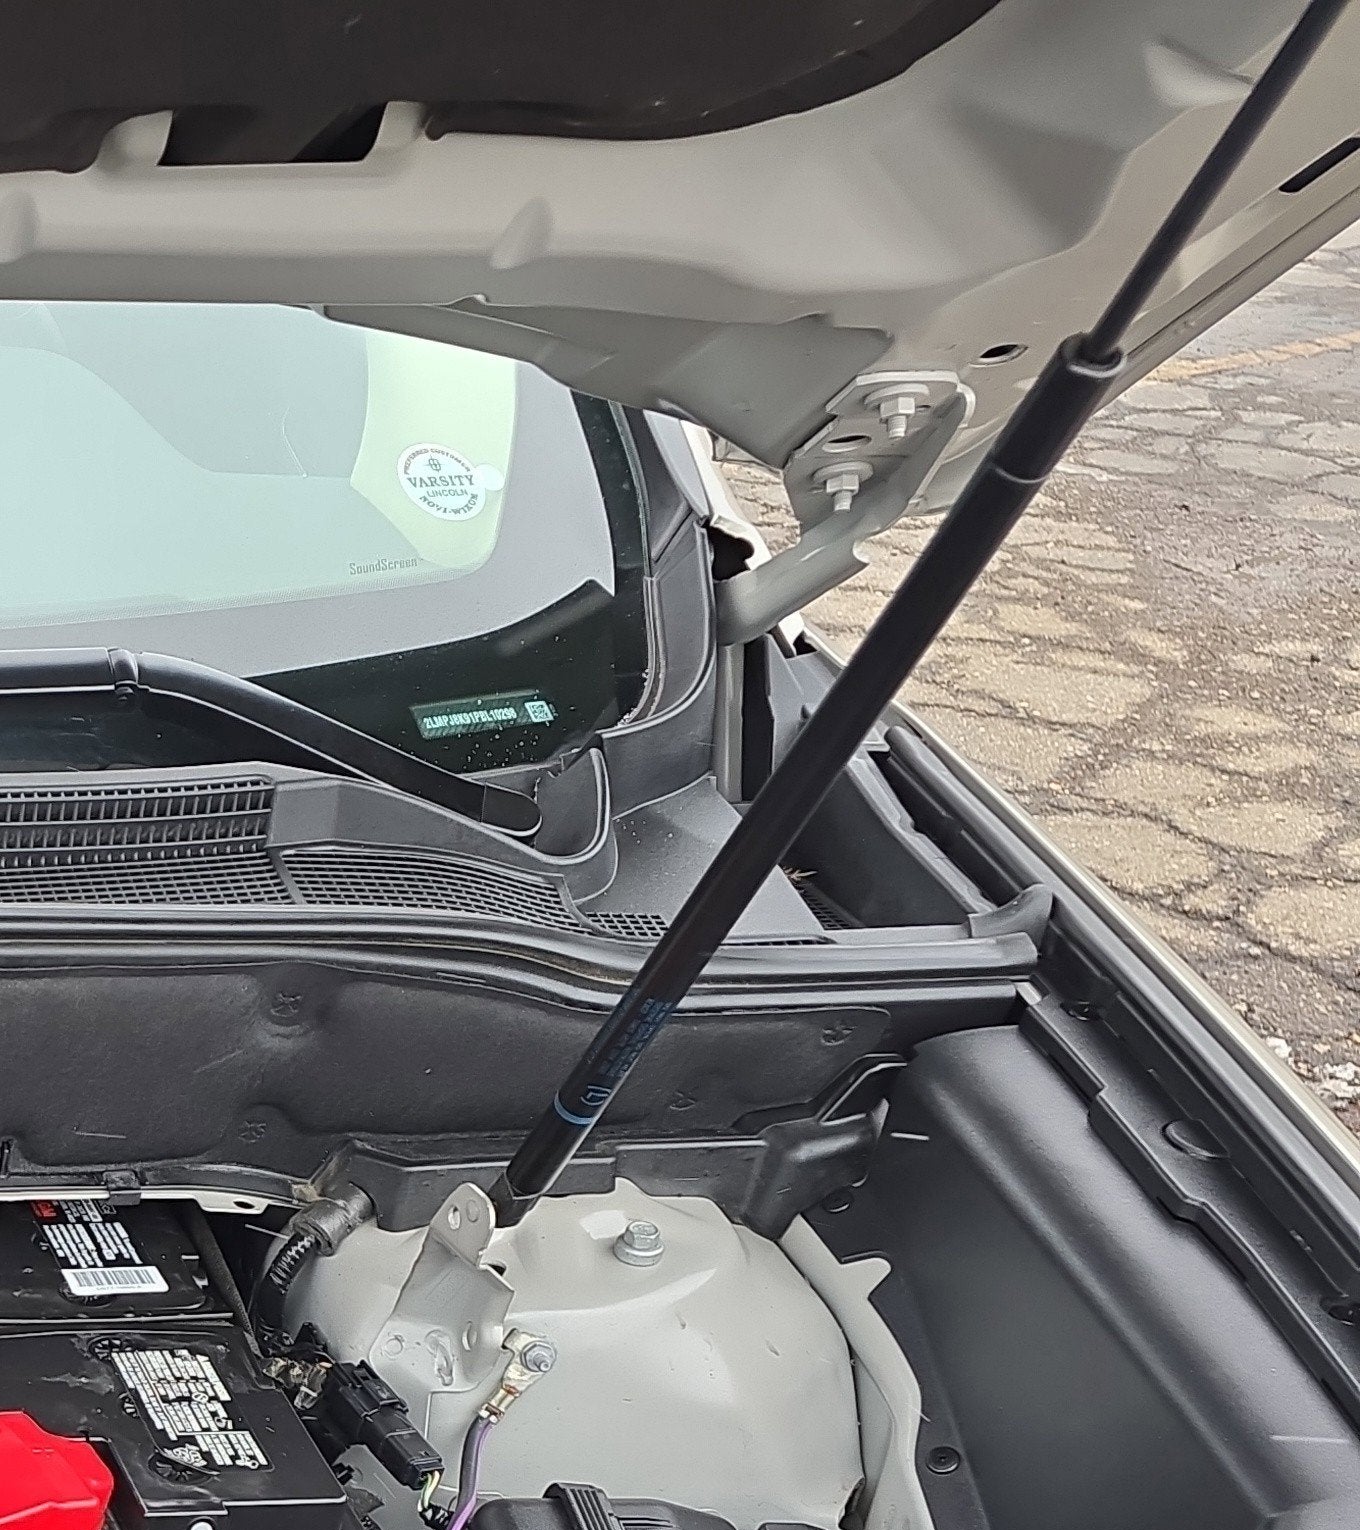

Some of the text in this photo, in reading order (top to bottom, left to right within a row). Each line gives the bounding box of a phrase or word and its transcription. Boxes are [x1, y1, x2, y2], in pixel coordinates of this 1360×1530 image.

[407, 475, 474, 488] VARSITY
[427, 488, 469, 498] LINCOLN
[349, 558, 418, 575] SoundScreen
